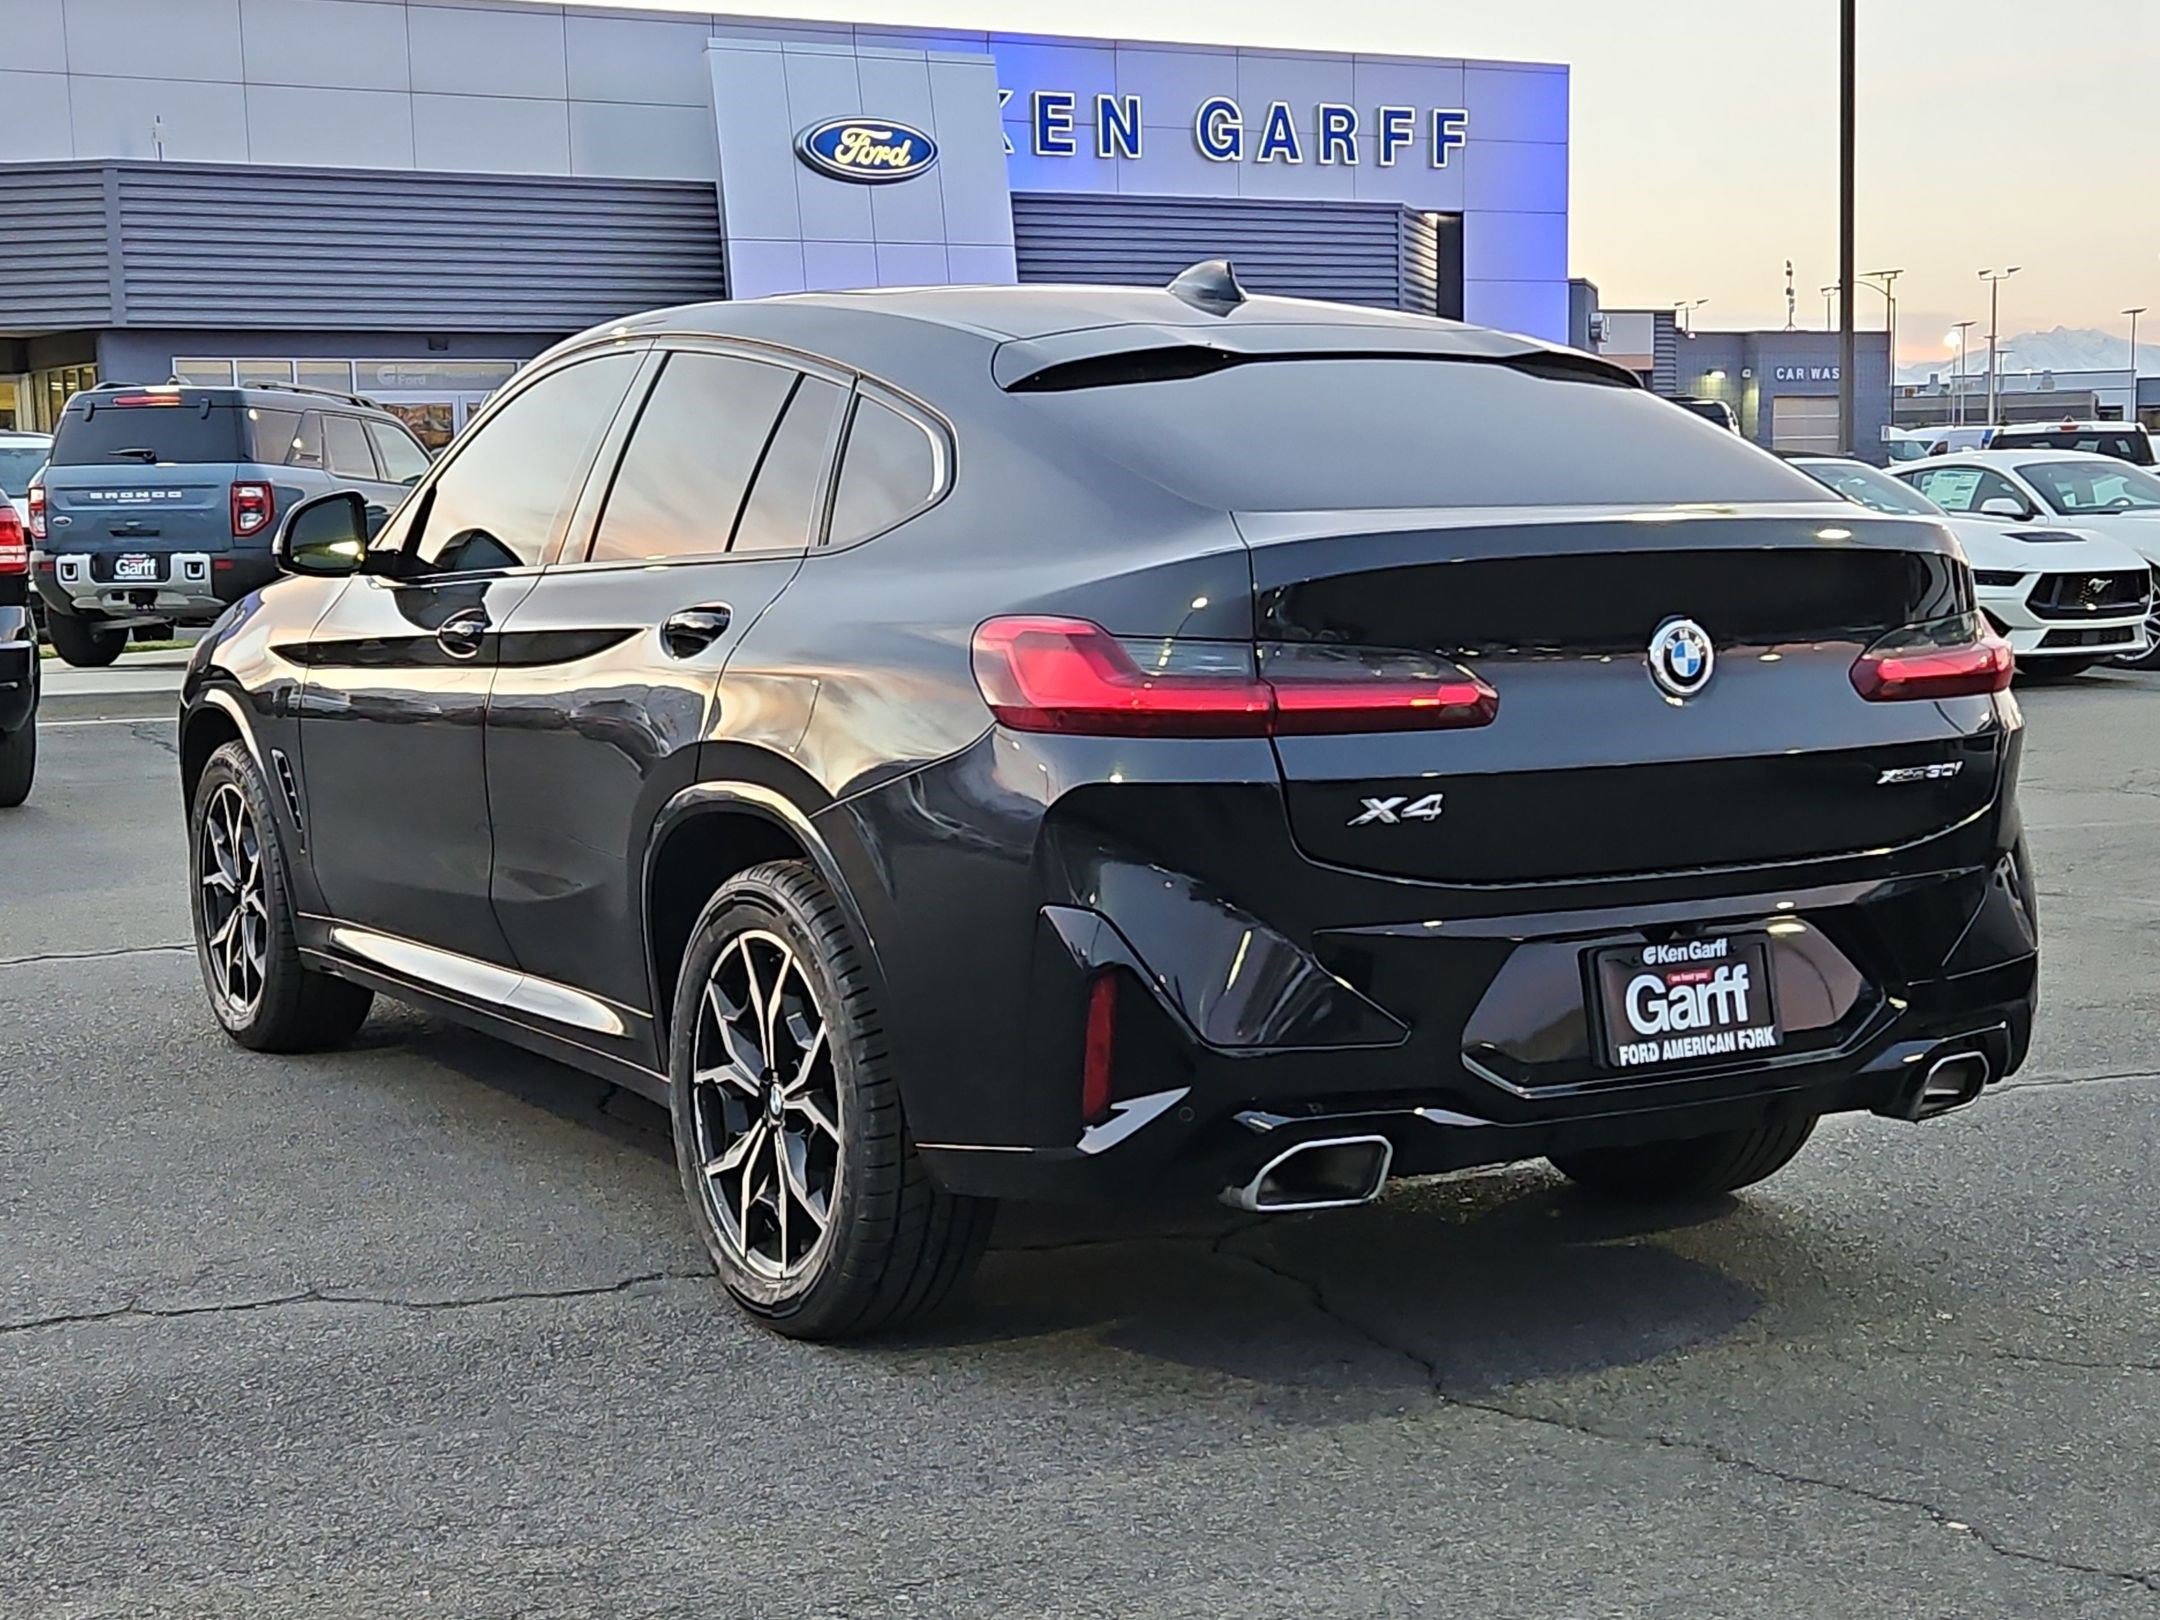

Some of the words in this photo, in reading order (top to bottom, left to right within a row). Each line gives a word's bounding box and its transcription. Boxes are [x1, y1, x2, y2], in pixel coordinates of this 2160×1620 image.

[834, 127, 912, 166] Ford
[1195, 96, 1468, 168] GARFF
[1776, 367, 1804, 380] CAR
[1810, 367, 1840, 380] WAS
[115, 558, 156, 575] Garff
[1346, 793, 1444, 826] X4
[1658, 944, 1687, 963] Ken
[1689, 938, 1728, 960] Garff
[1625, 963, 1749, 1035] Garff
[1619, 1041, 1660, 1067] FORD
[1662, 1031, 1737, 1061] AMERICAN
[1738, 1025, 1777, 1051] FORK
